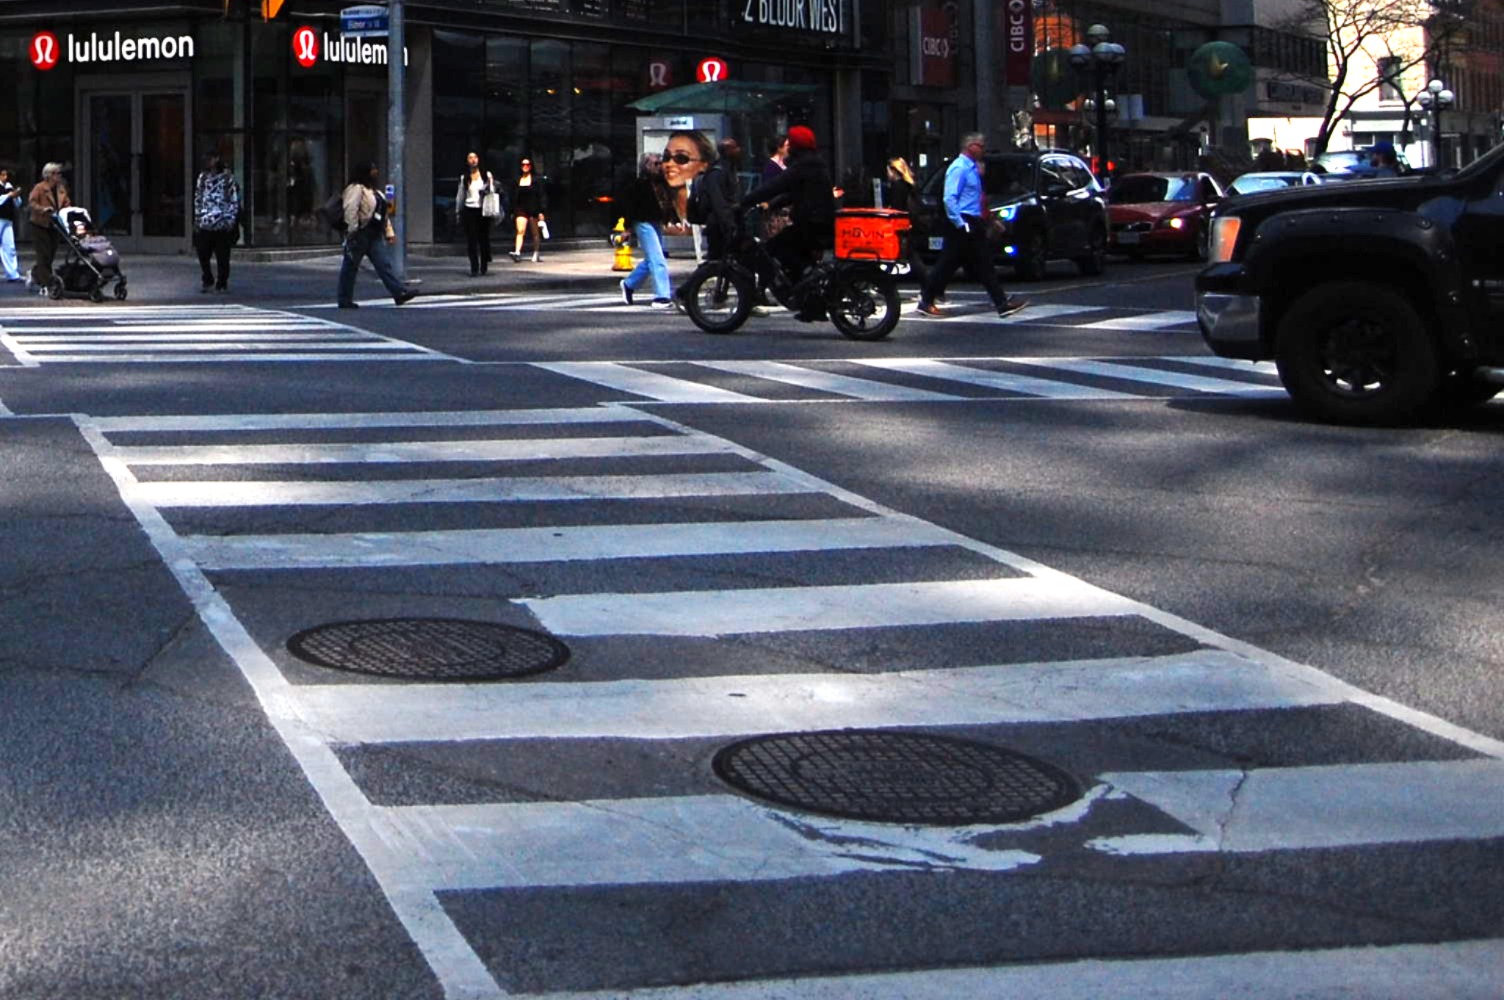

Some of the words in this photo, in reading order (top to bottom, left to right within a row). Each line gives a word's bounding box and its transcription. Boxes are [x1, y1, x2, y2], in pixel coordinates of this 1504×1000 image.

[67, 31, 194, 63] lululemon
[324, 31, 408, 67] lululem
[1010, 14, 1025, 52] CIBC
